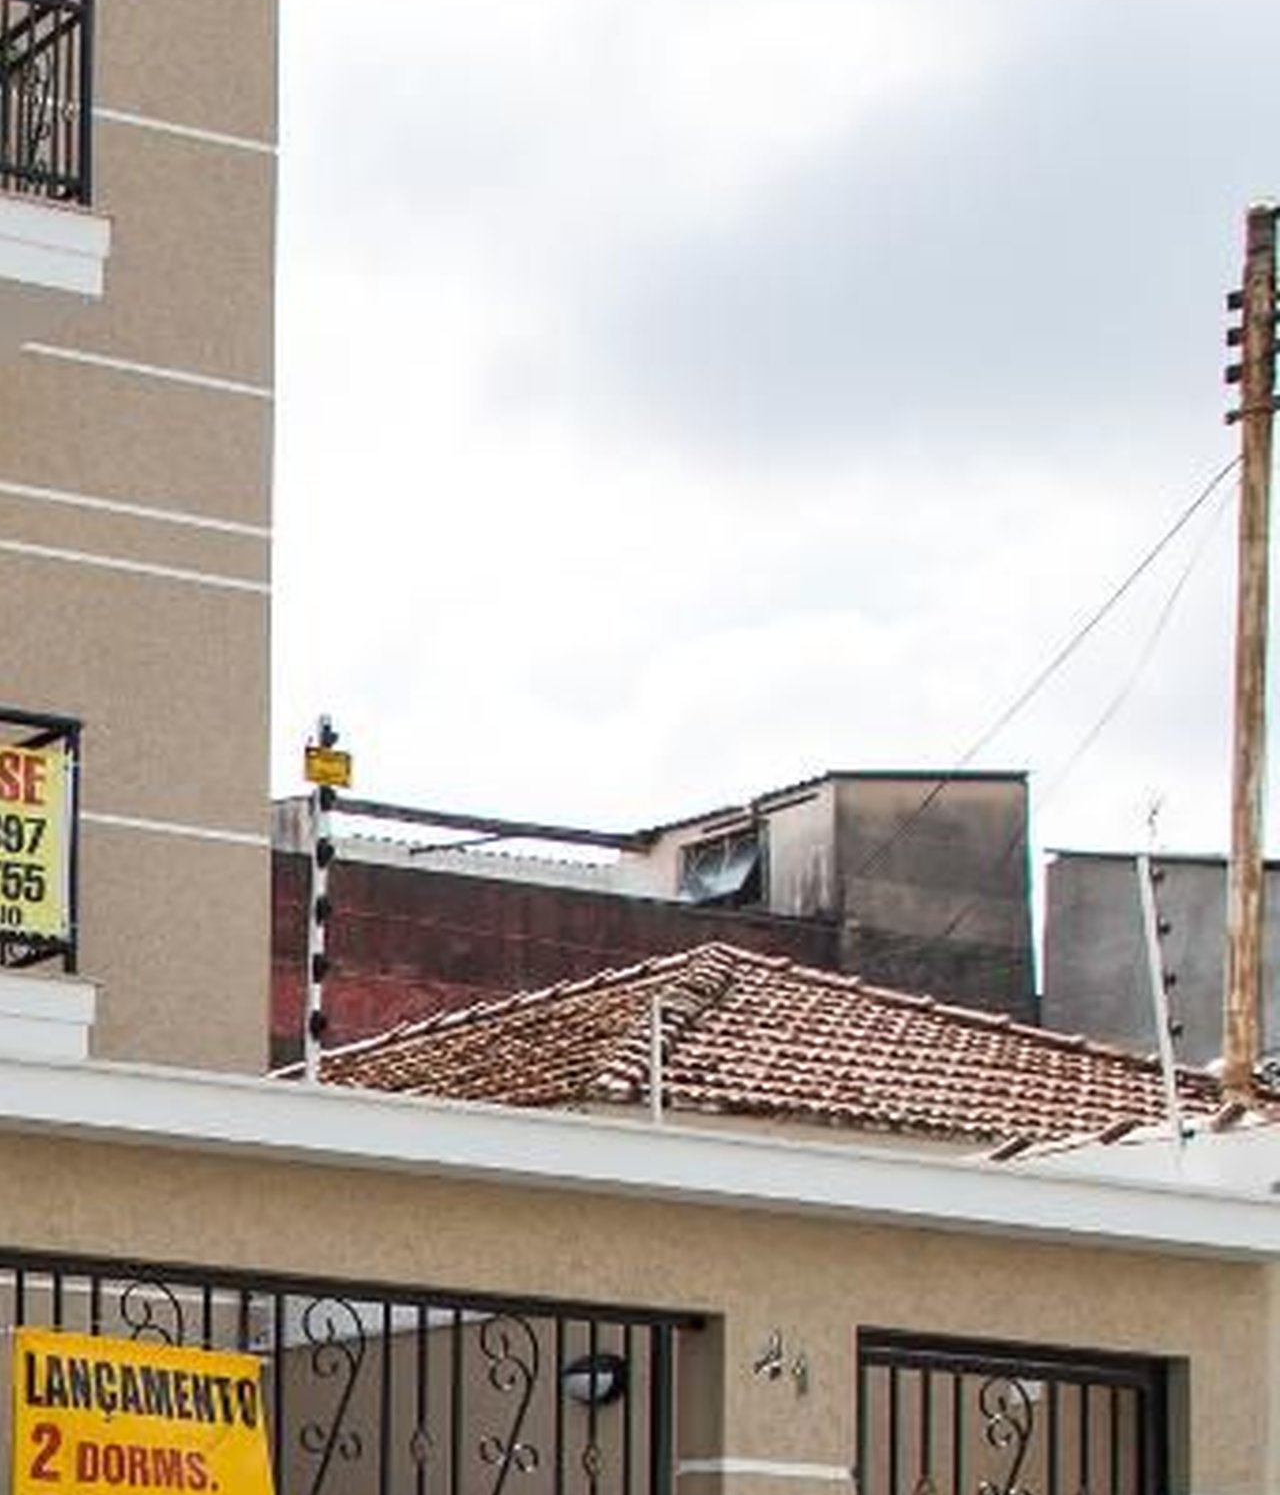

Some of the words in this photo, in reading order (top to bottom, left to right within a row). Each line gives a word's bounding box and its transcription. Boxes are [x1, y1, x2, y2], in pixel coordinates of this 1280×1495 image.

[25, 1351, 257, 1428] LANÇAMENTO
[30, 1422, 62, 1482] 2
[76, 1441, 219, 1492] DORMS.
